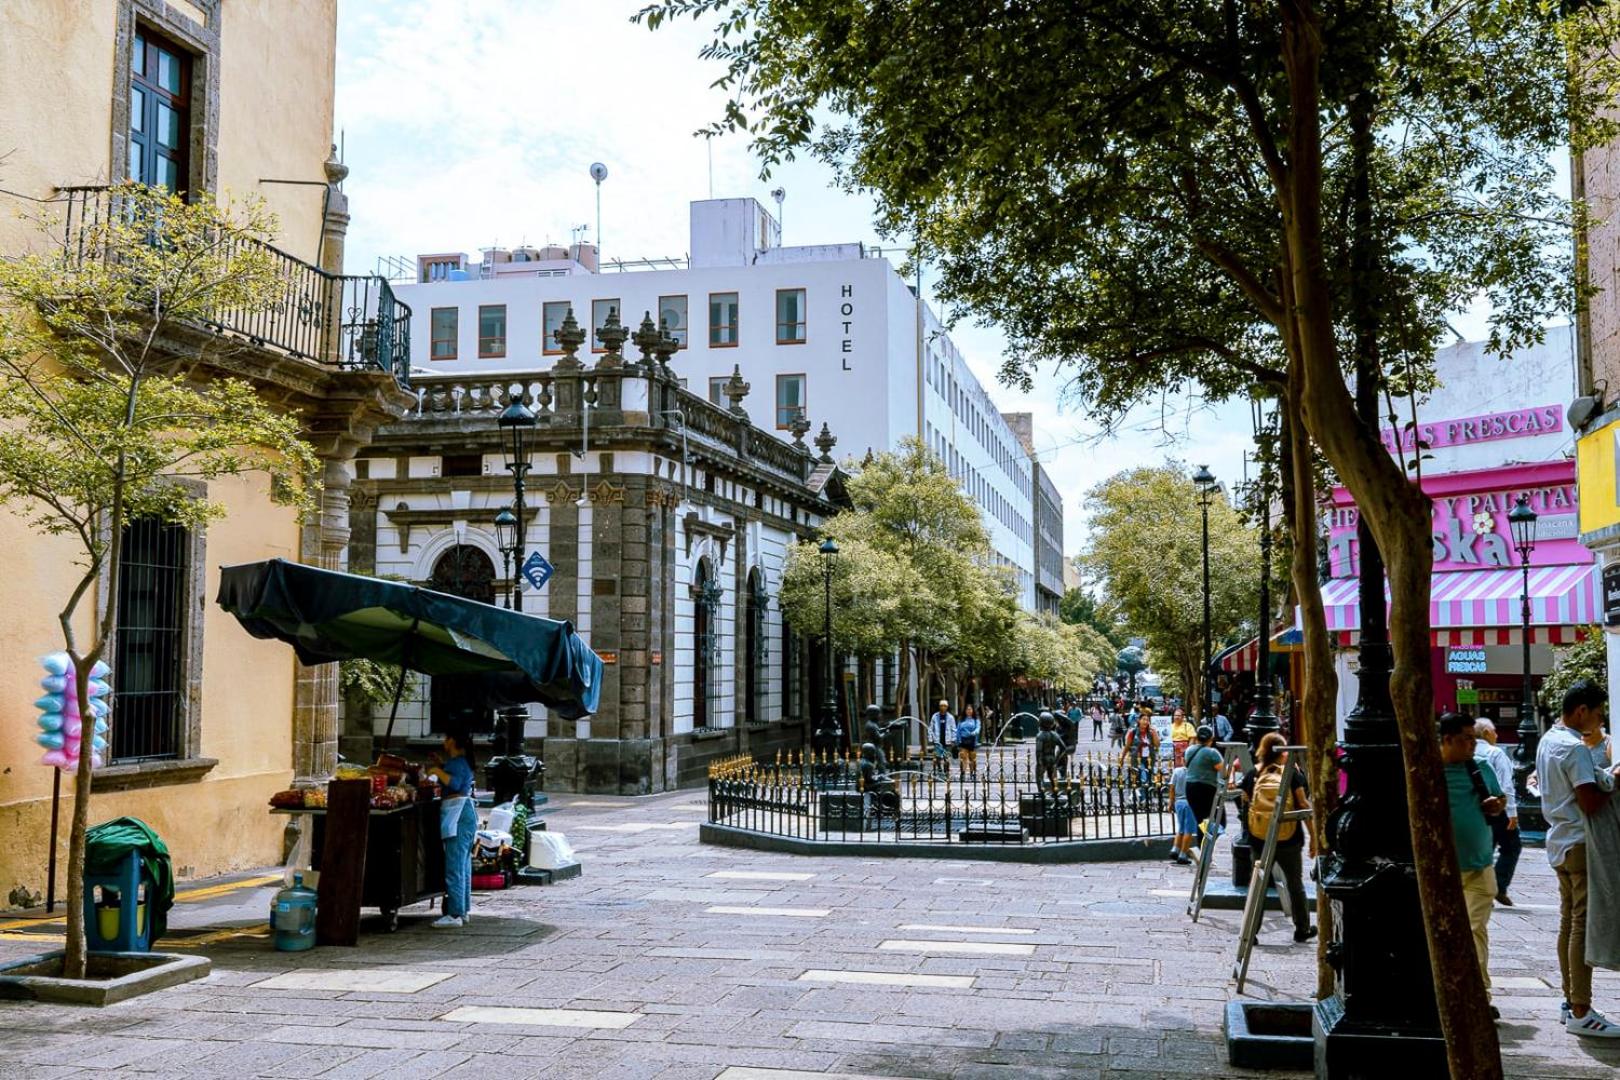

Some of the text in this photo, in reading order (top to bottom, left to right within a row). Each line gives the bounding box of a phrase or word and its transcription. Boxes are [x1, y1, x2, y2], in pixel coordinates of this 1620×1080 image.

[841, 284, 853, 371] HOTEL
[1447, 408, 1559, 444] FRESCAS
[1449, 650, 1486, 661] AGUAS
